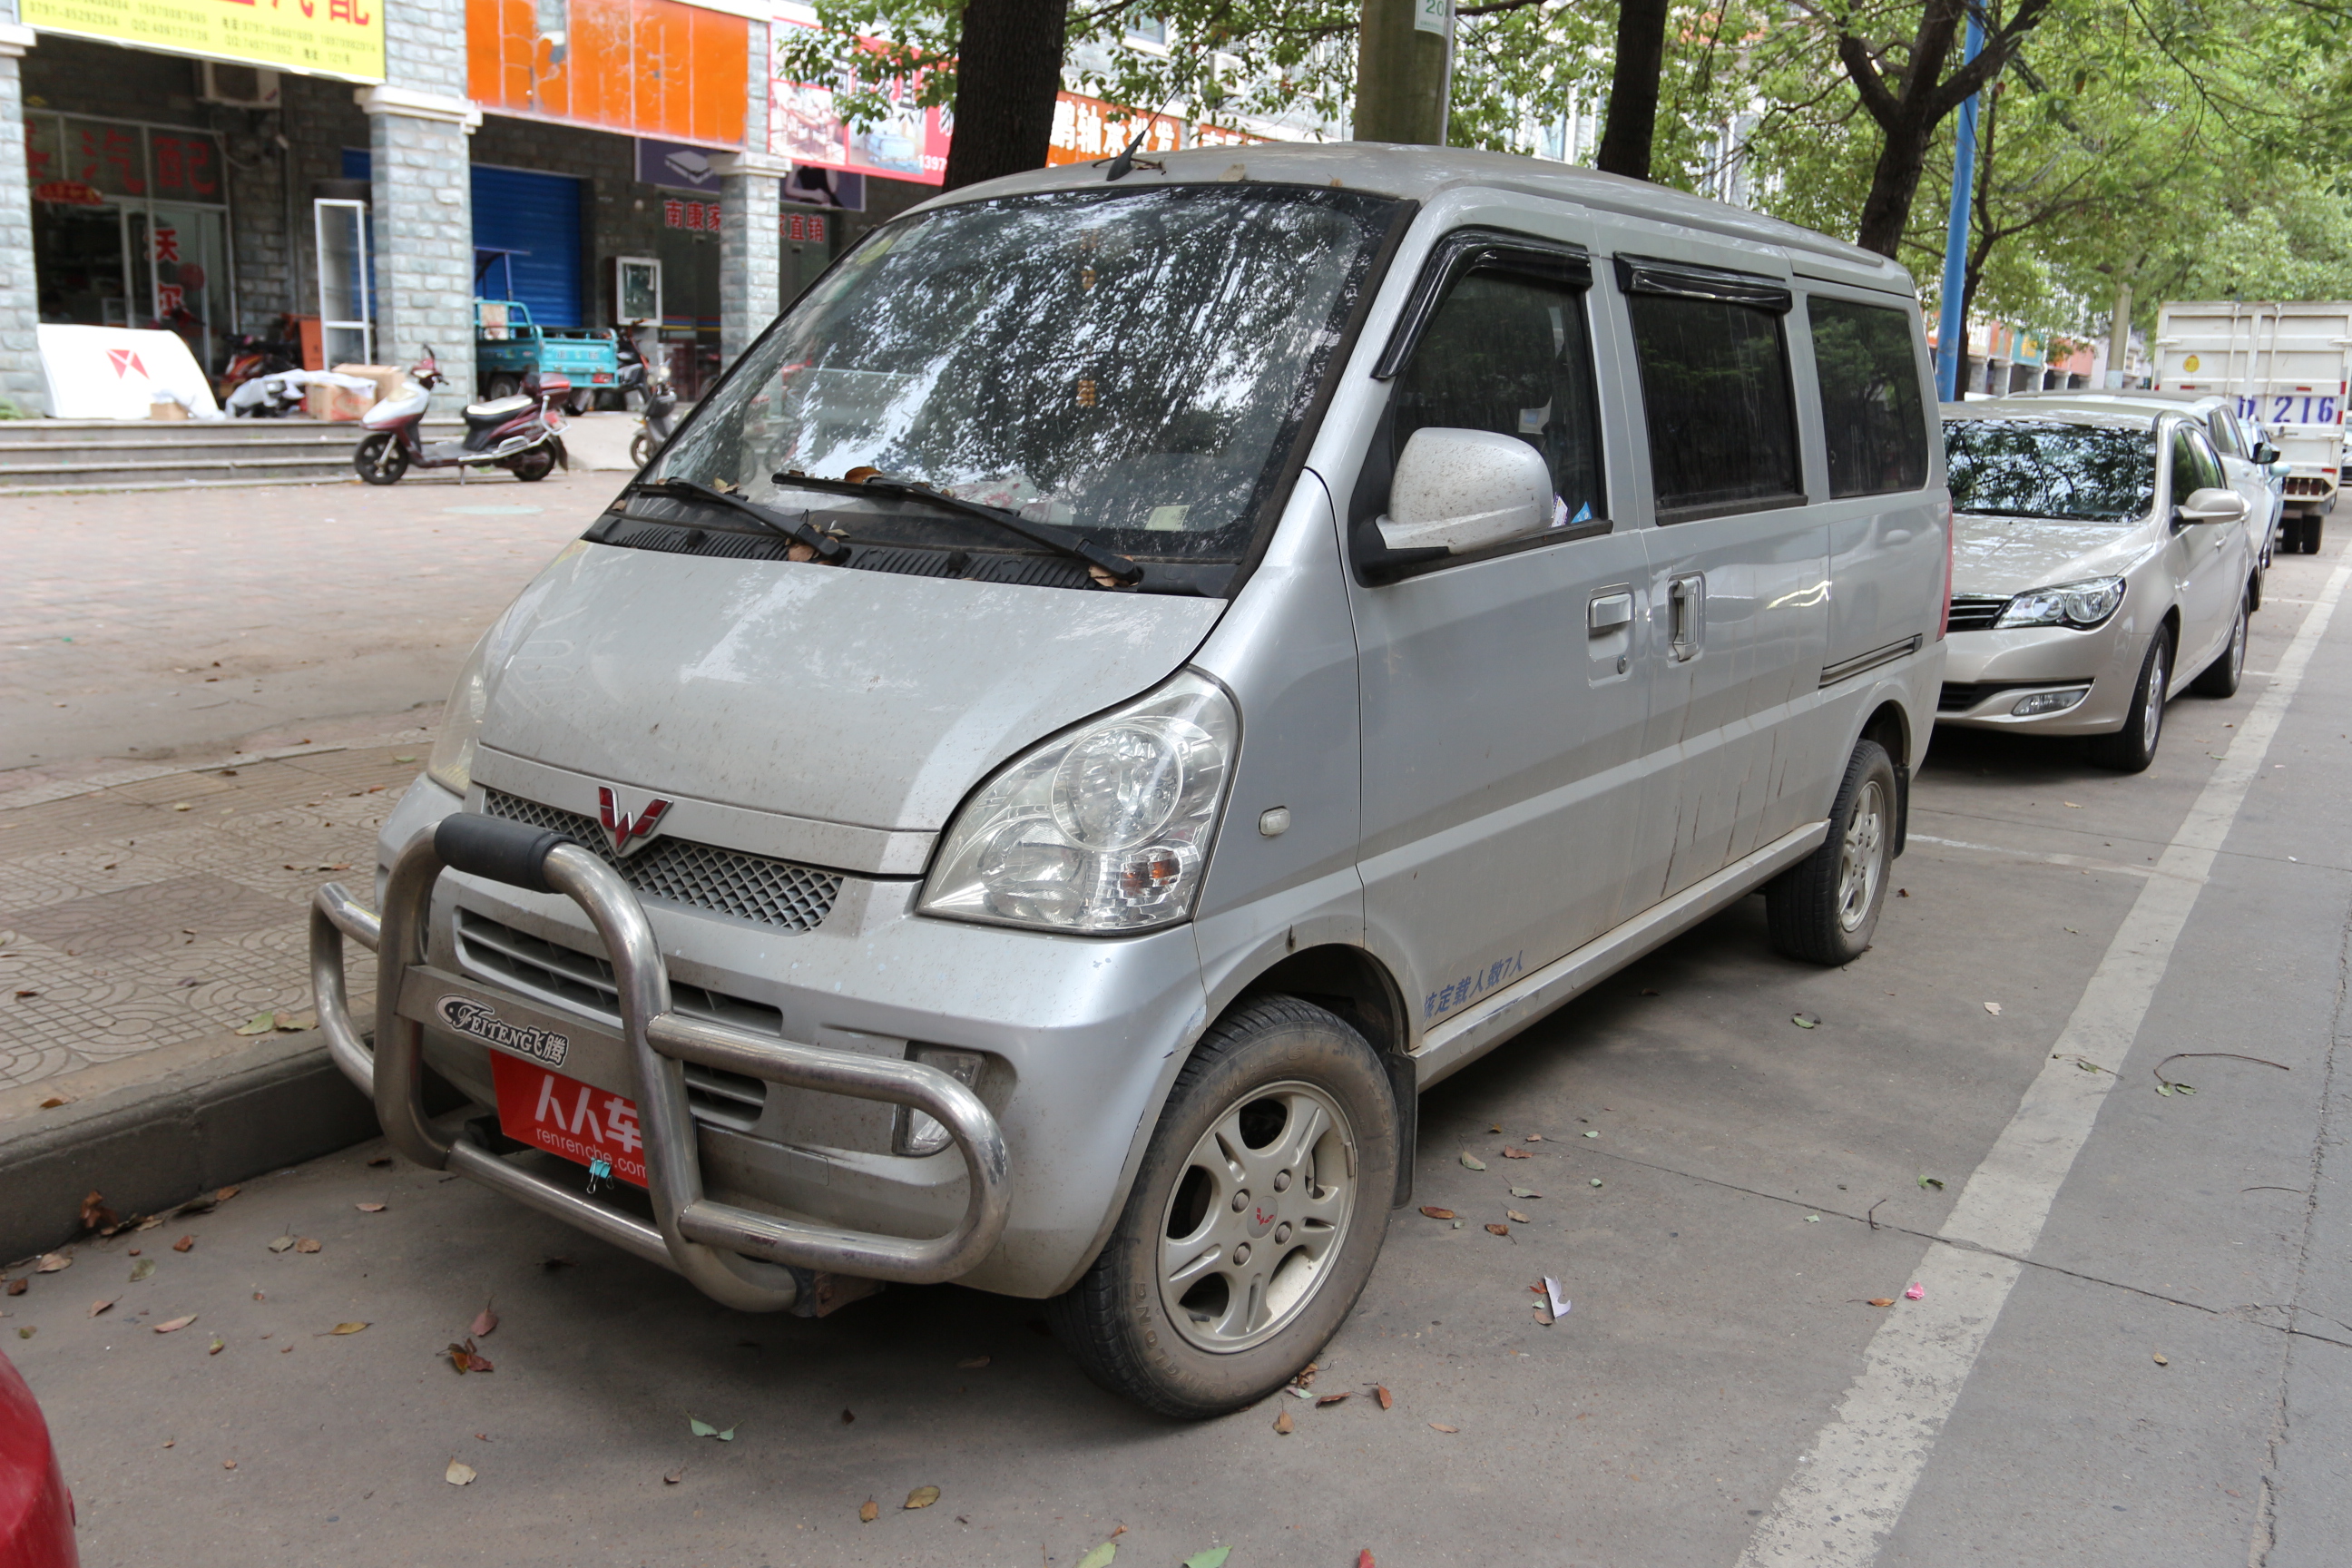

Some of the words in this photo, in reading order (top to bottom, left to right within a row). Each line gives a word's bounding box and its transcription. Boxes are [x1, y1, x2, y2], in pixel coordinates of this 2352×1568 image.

[452, 1004, 534, 1053] FEITENG
[528, 1027, 566, 1064] 飞腾
[534, 1073, 643, 1154] 人人车
